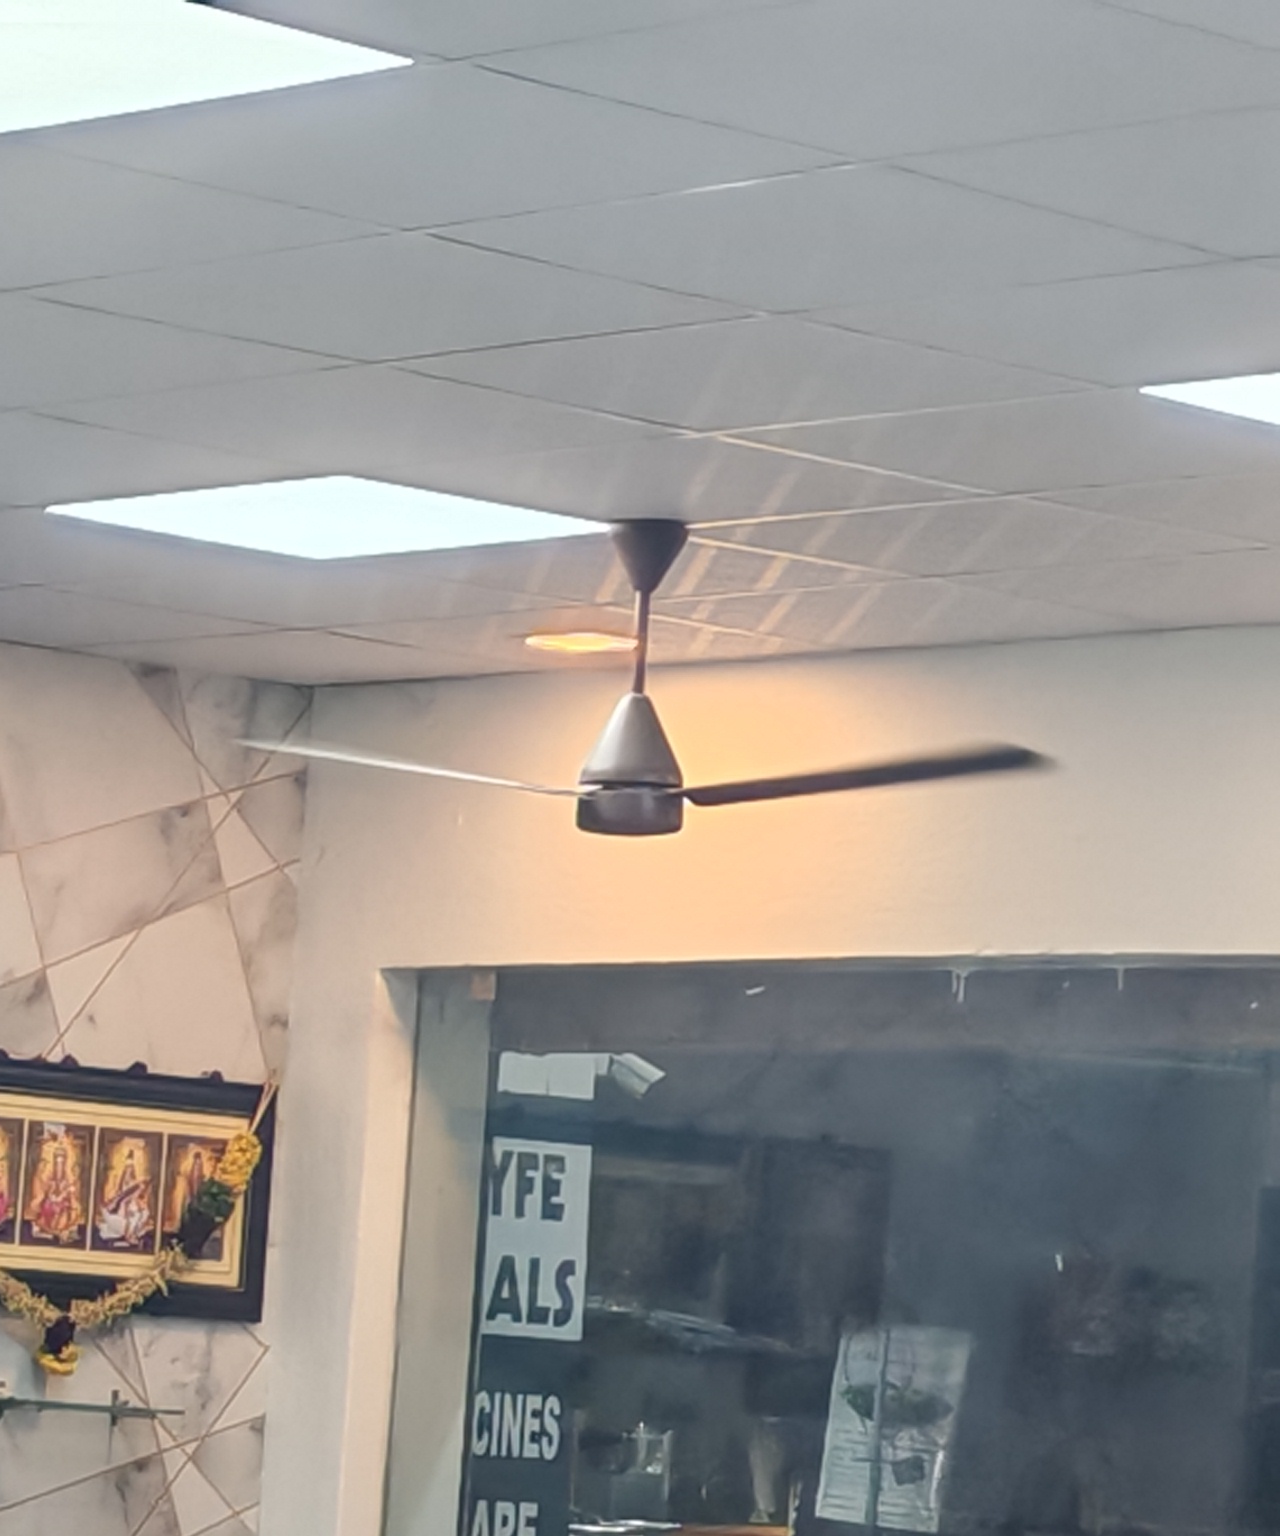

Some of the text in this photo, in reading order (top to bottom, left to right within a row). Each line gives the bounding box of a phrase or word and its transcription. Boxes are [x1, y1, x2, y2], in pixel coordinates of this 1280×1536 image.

[490, 1148, 566, 1222] YFE
[485, 1255, 576, 1328] ALS
[472, 1389, 561, 1461] CINES
